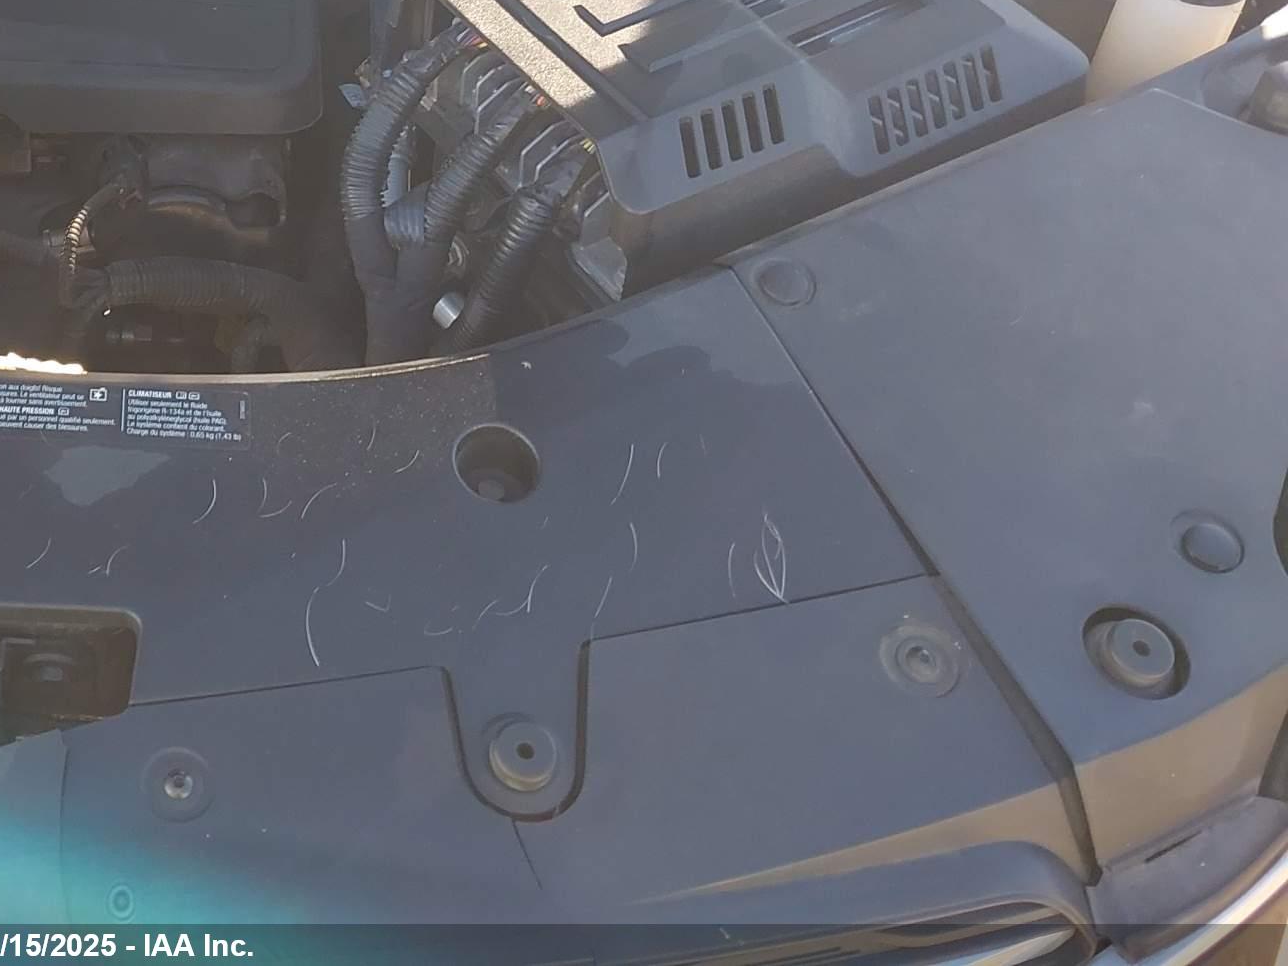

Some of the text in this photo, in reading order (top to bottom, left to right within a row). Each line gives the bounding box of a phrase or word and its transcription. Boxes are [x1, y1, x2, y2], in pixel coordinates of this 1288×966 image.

[61, 393, 75, 401] peut
[128, 389, 172, 399] CLIMATISEUR
[150, 400, 182, 408] seulement
[0, 405, 20, 414] HAUTE
[22, 406, 55, 415] PRESSION
[28, 415, 58, 424] personnel
[127, 428, 149, 436] Charge
